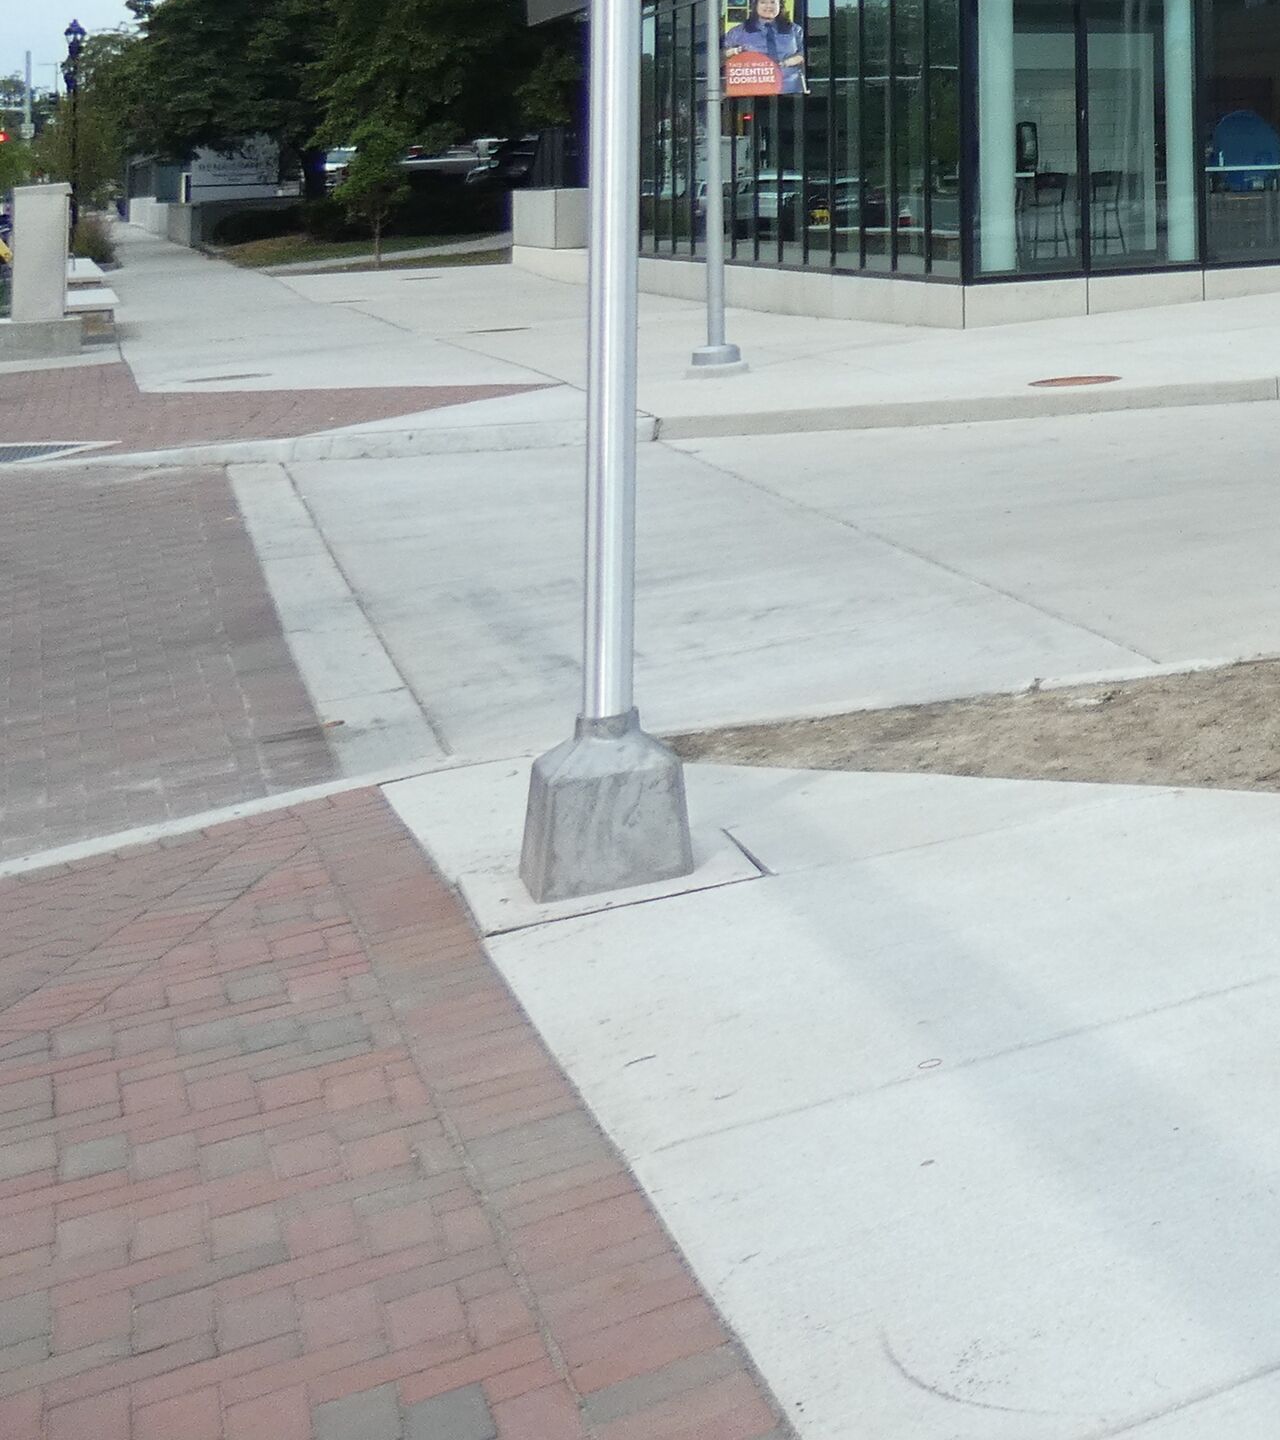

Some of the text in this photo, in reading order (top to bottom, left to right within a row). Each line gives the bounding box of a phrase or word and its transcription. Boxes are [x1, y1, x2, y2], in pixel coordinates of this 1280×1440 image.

[729, 67, 775, 76] SCIENTIST
[729, 75, 776, 85] LOOKS LIKE
